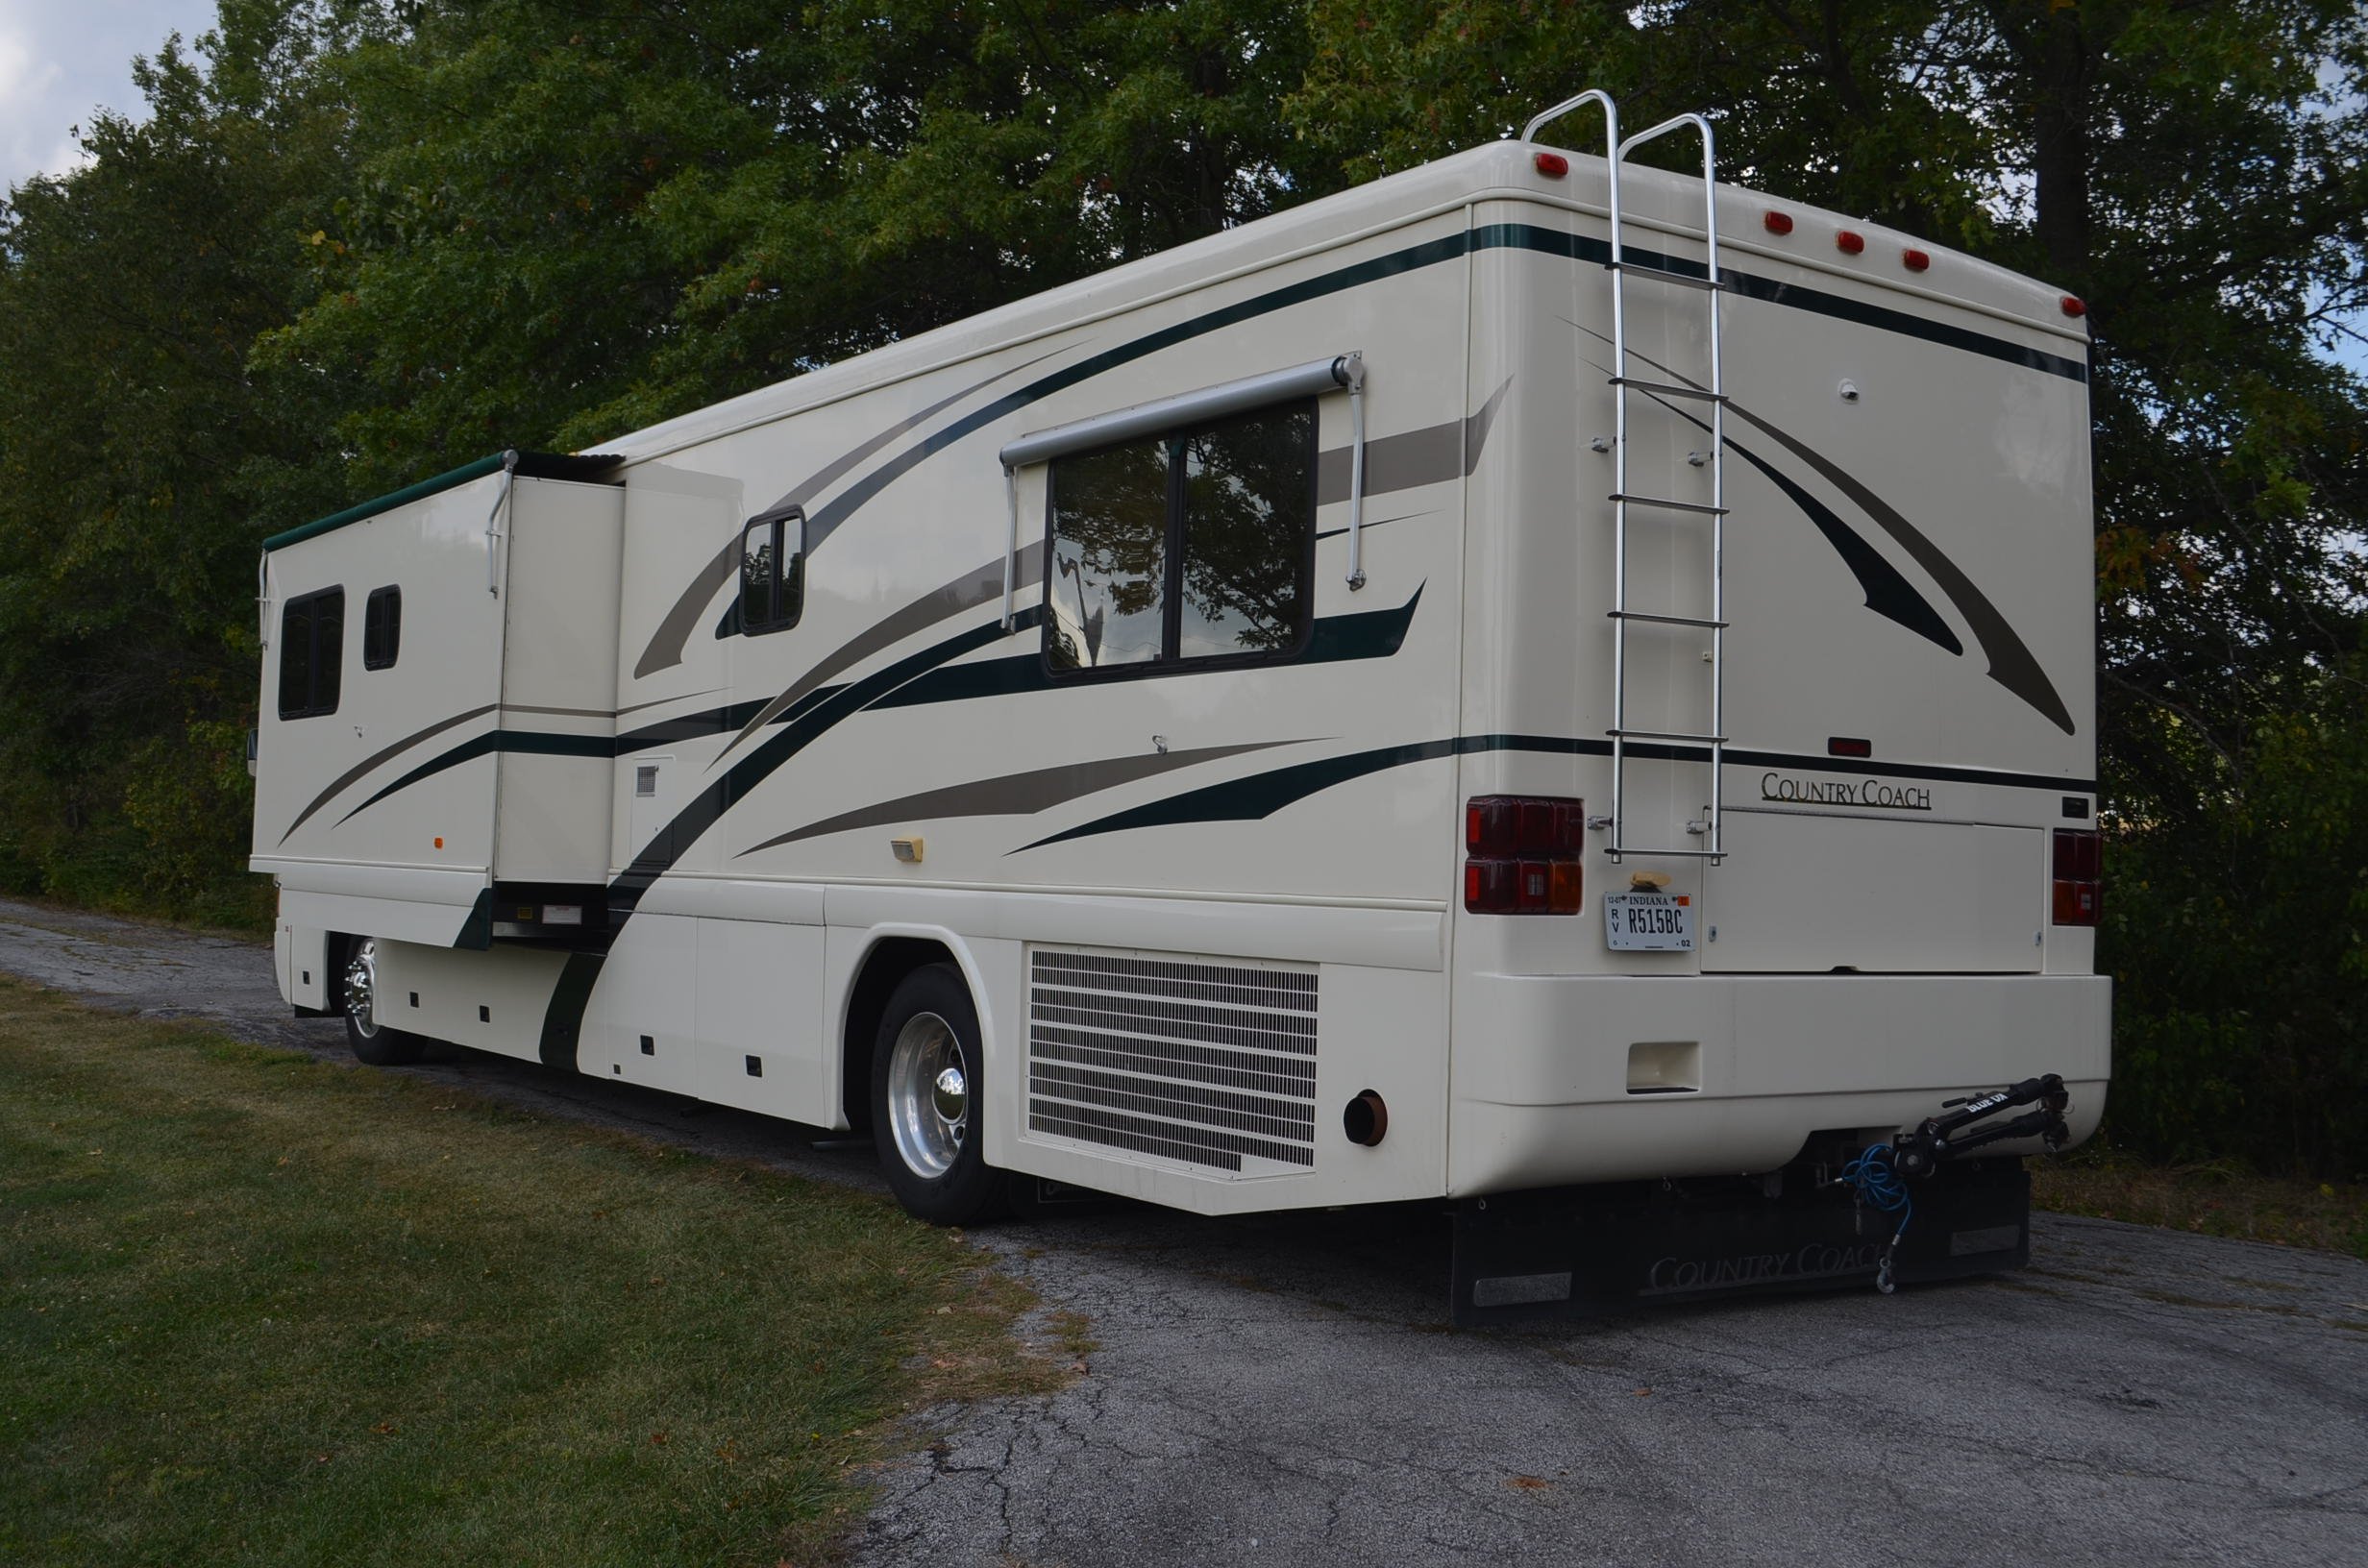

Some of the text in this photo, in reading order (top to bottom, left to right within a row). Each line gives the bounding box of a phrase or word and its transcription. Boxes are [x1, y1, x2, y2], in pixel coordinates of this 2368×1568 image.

[1761, 772, 1930, 808] COUNTRY COACH
[1629, 896, 1668, 905] INDIANA
[1628, 908, 1683, 934] R515BC
[1649, 1253, 1790, 1291] COUNTRY
